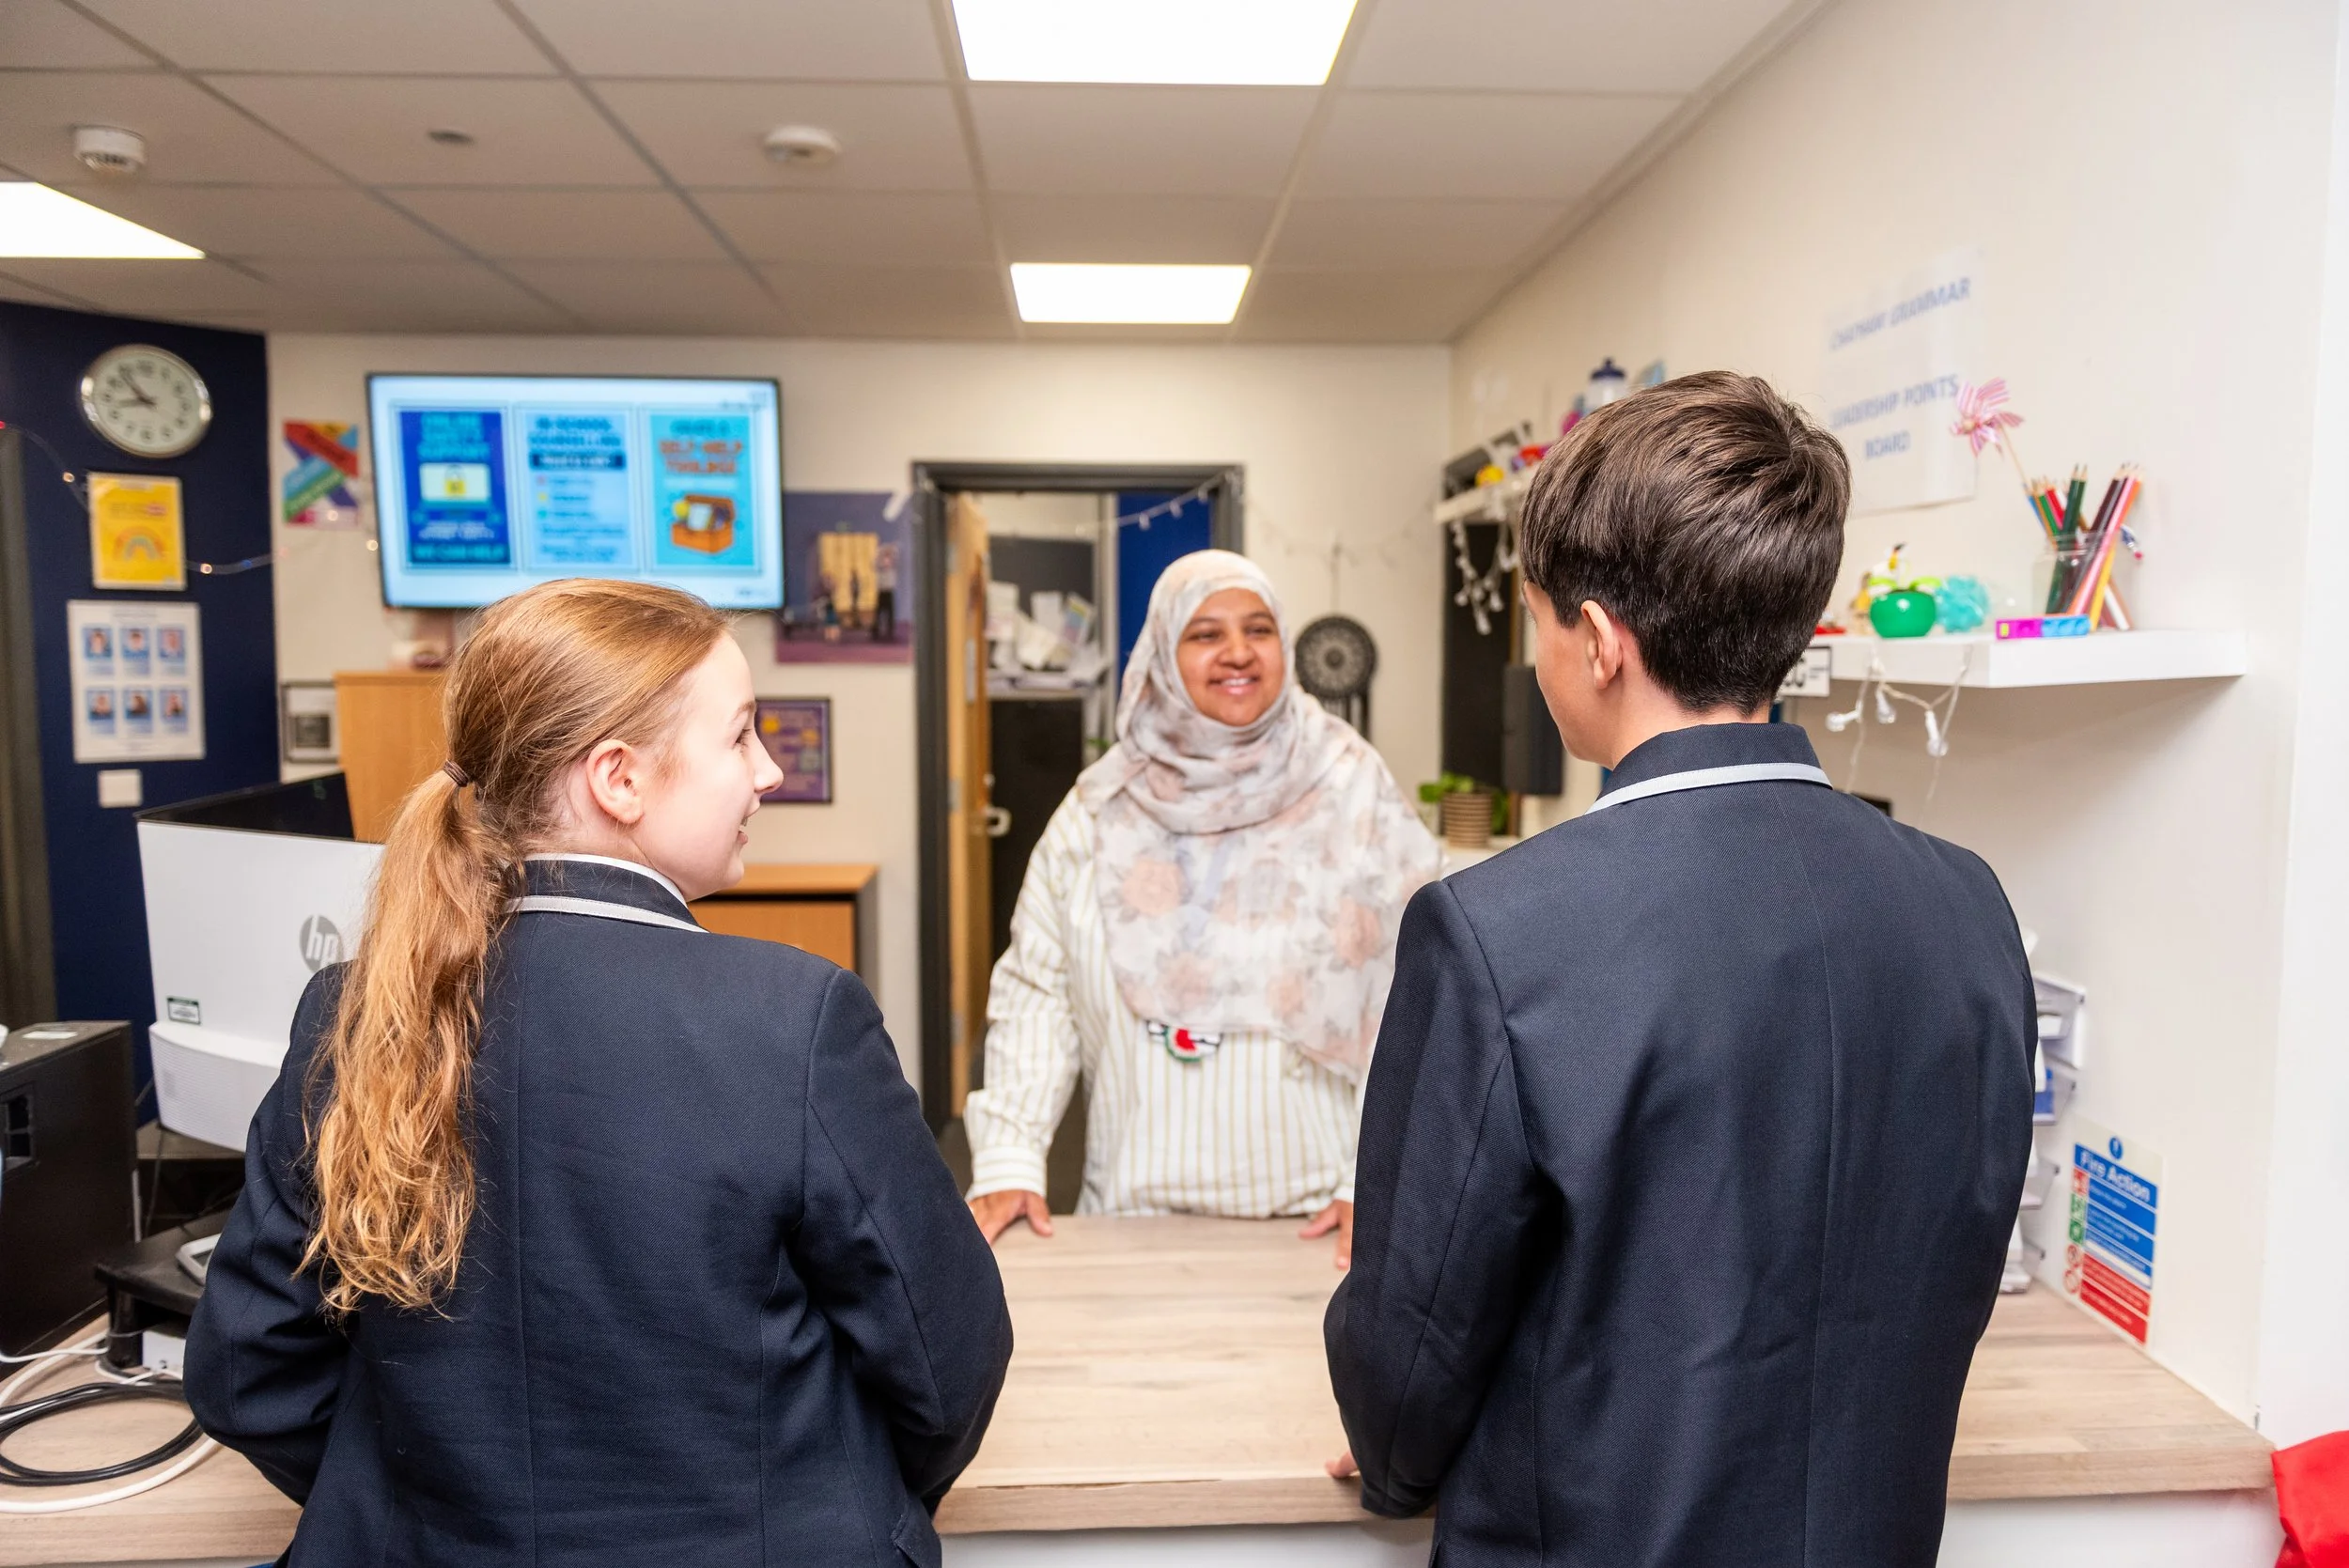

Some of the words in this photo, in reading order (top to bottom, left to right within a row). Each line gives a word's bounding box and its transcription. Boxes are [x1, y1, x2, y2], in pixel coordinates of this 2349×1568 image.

[1890, 277, 1971, 326] GRAMMAR
[1904, 374, 1959, 406] POINTS
[1865, 430, 1911, 460] BOARD
[2080, 1150, 2106, 1179] Fire
[2107, 1165, 2151, 1203] Action
